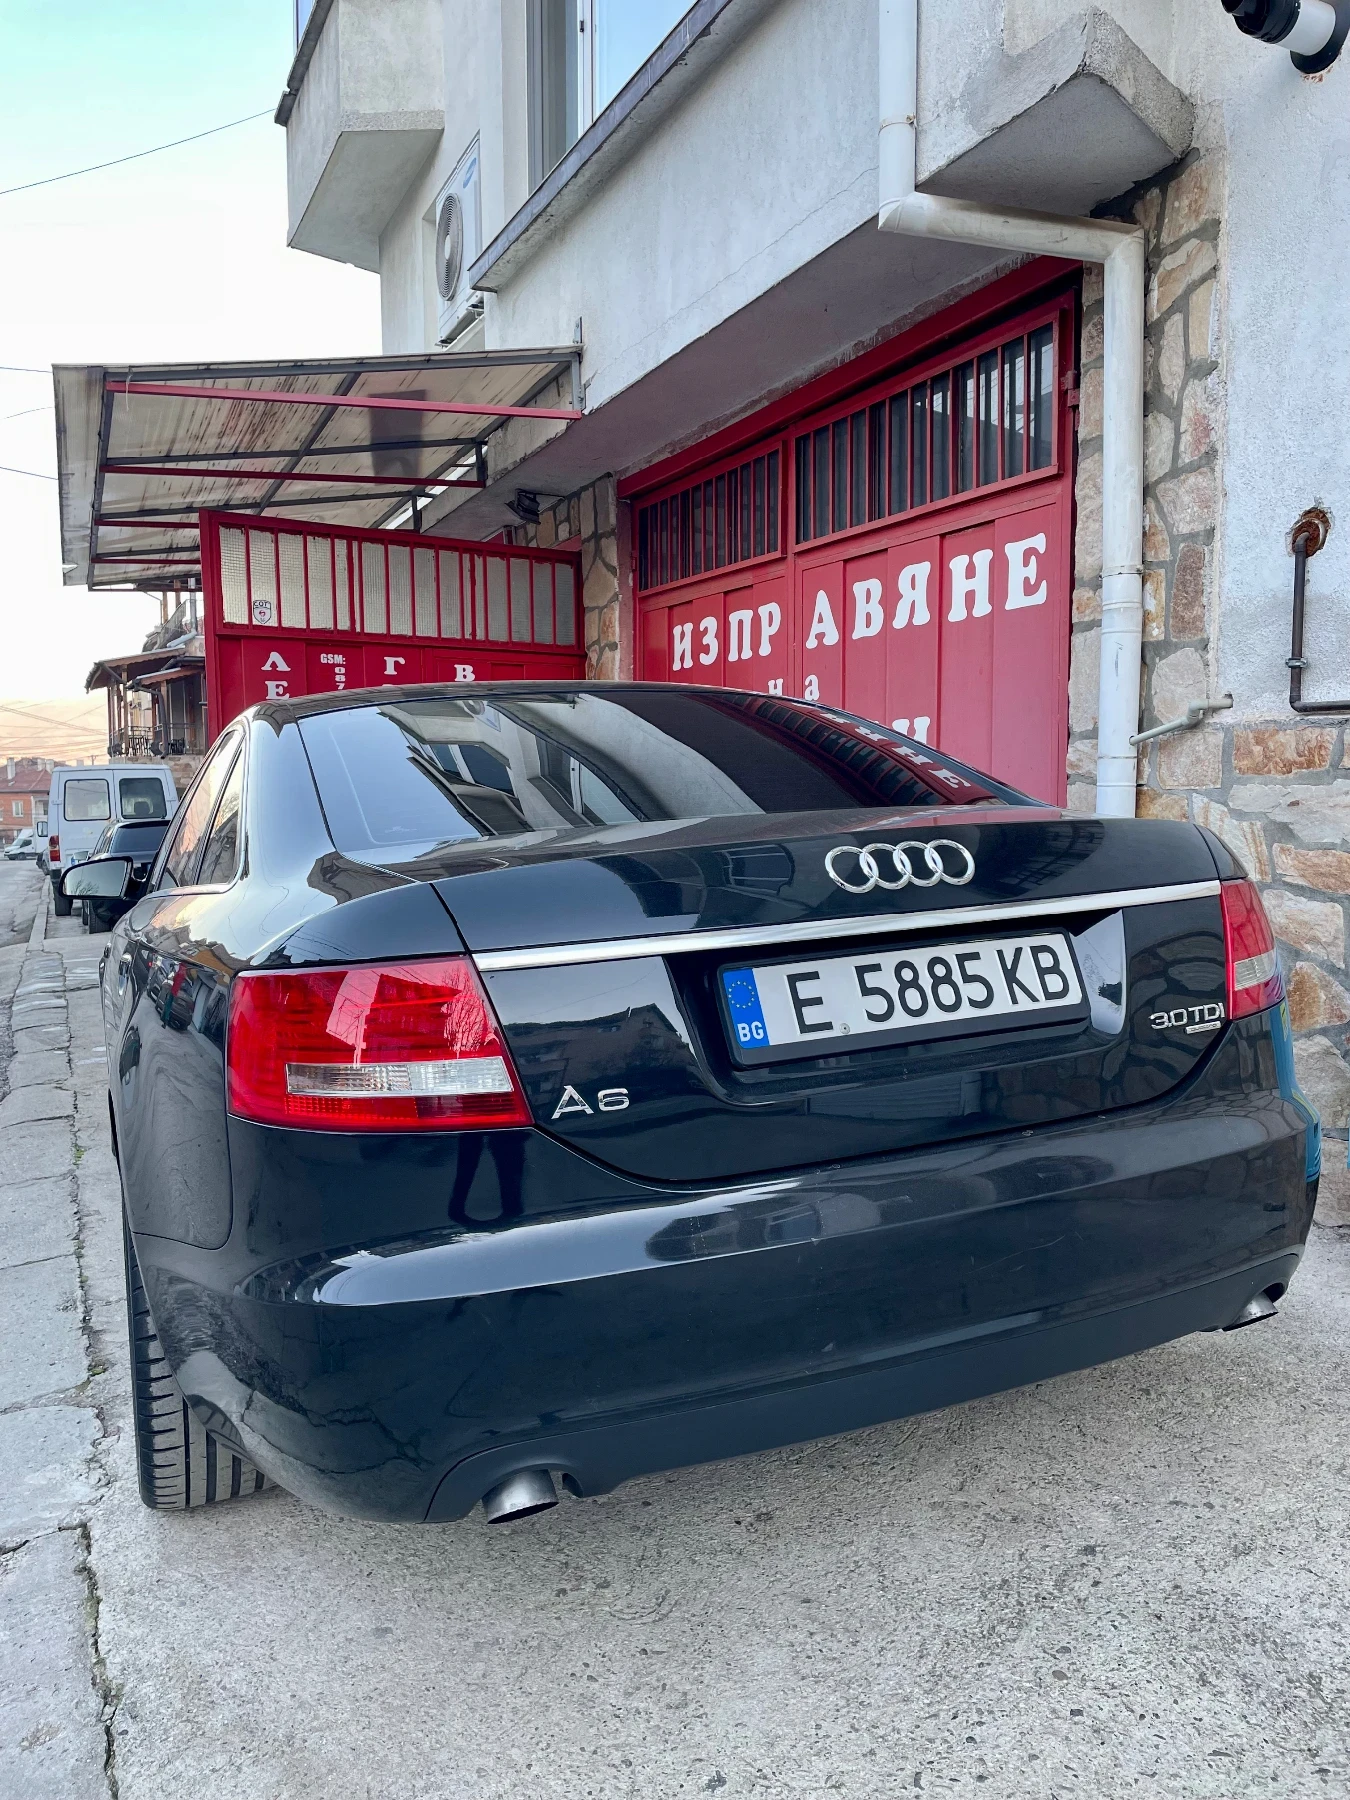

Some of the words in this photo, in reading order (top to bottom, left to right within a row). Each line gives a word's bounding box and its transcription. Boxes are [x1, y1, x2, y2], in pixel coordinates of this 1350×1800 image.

[320, 653, 346, 665] GSM:
[787, 971, 833, 1034] E
[738, 1021, 765, 1042] BG
[551, 1085, 630, 1119] A6
